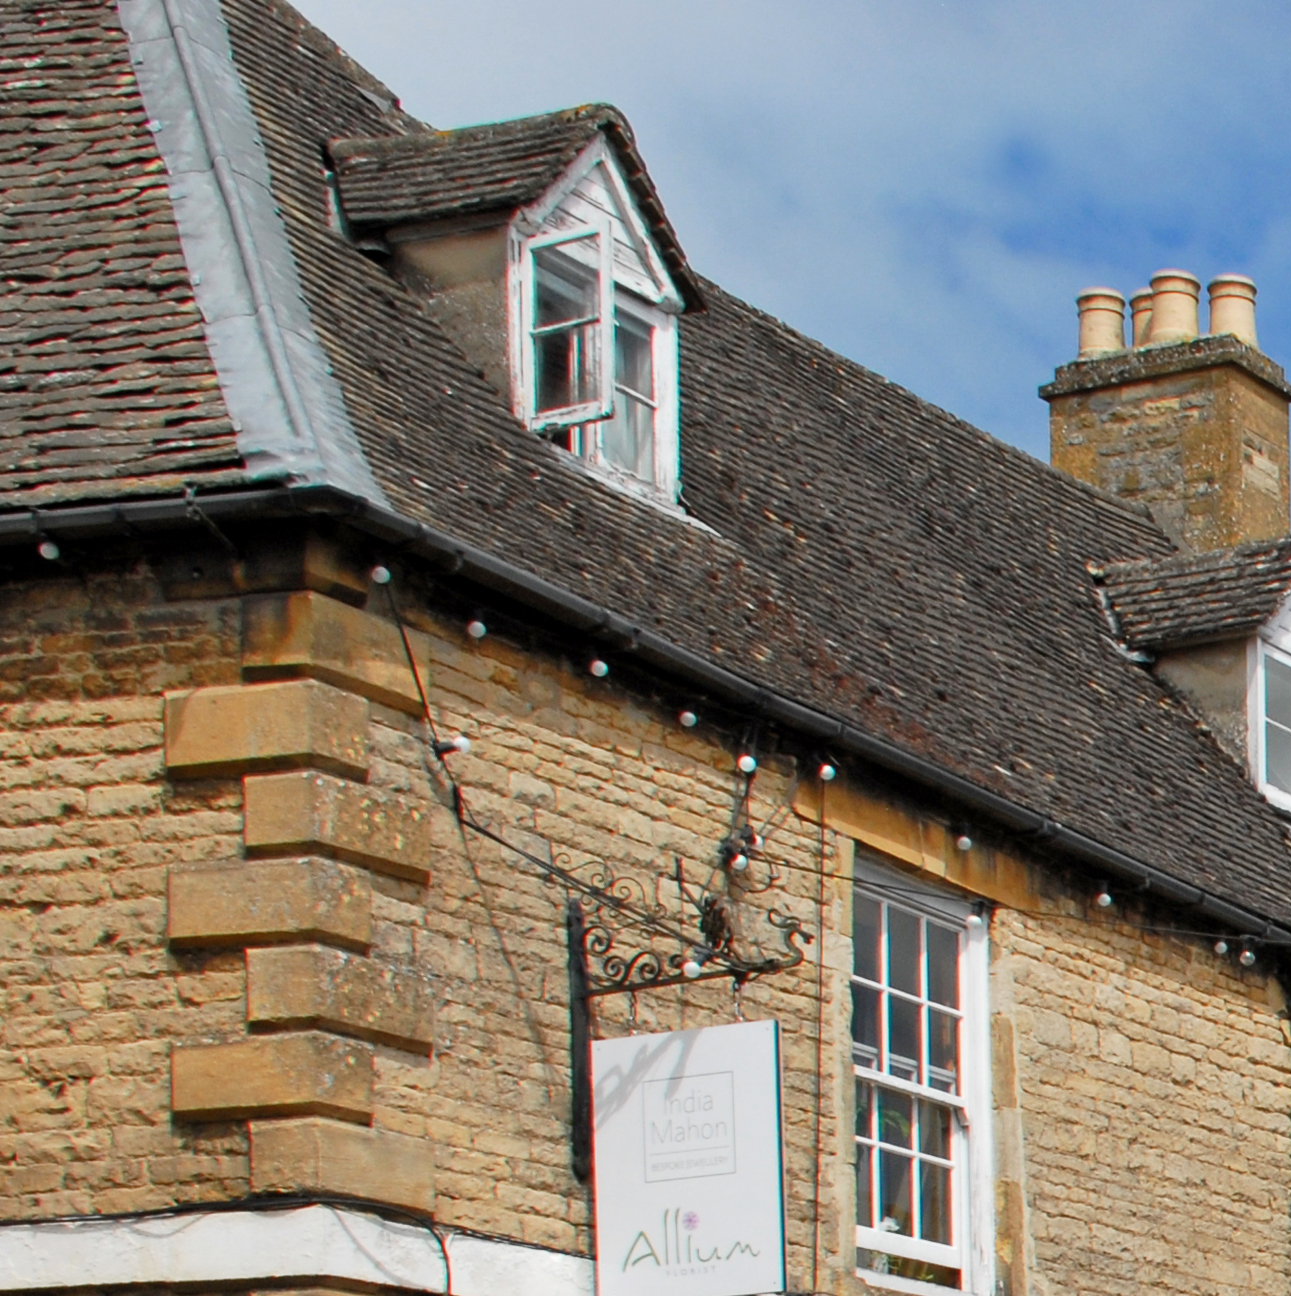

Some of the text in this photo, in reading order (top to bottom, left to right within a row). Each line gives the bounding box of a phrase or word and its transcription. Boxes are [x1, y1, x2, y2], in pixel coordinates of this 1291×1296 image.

[663, 1089, 714, 1115] India
[651, 1118, 728, 1145] Mahon
[622, 1207, 761, 1273] Allium
